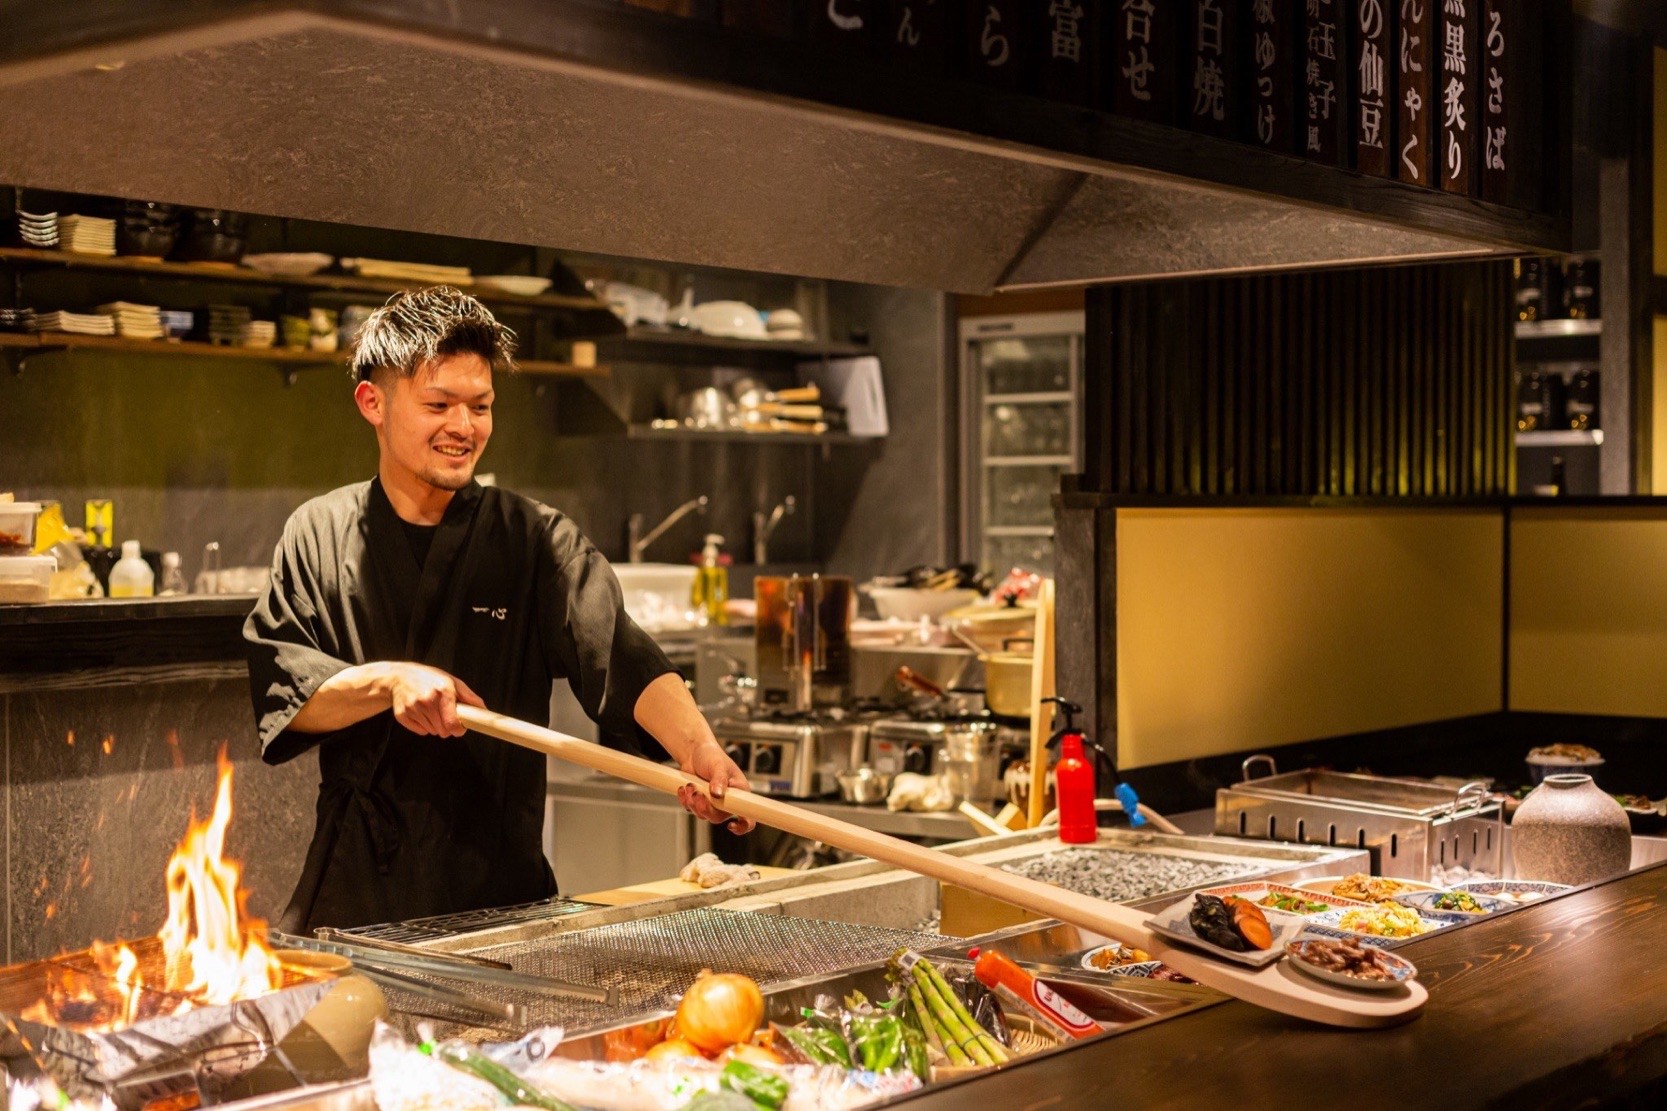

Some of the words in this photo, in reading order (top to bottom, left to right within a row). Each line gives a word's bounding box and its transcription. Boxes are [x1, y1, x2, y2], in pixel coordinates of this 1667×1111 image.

[1316, 0, 1337, 120] 玉子
[1358, 0, 1384, 149] の仙豆
[1485, 11, 1507, 171] ろさば
